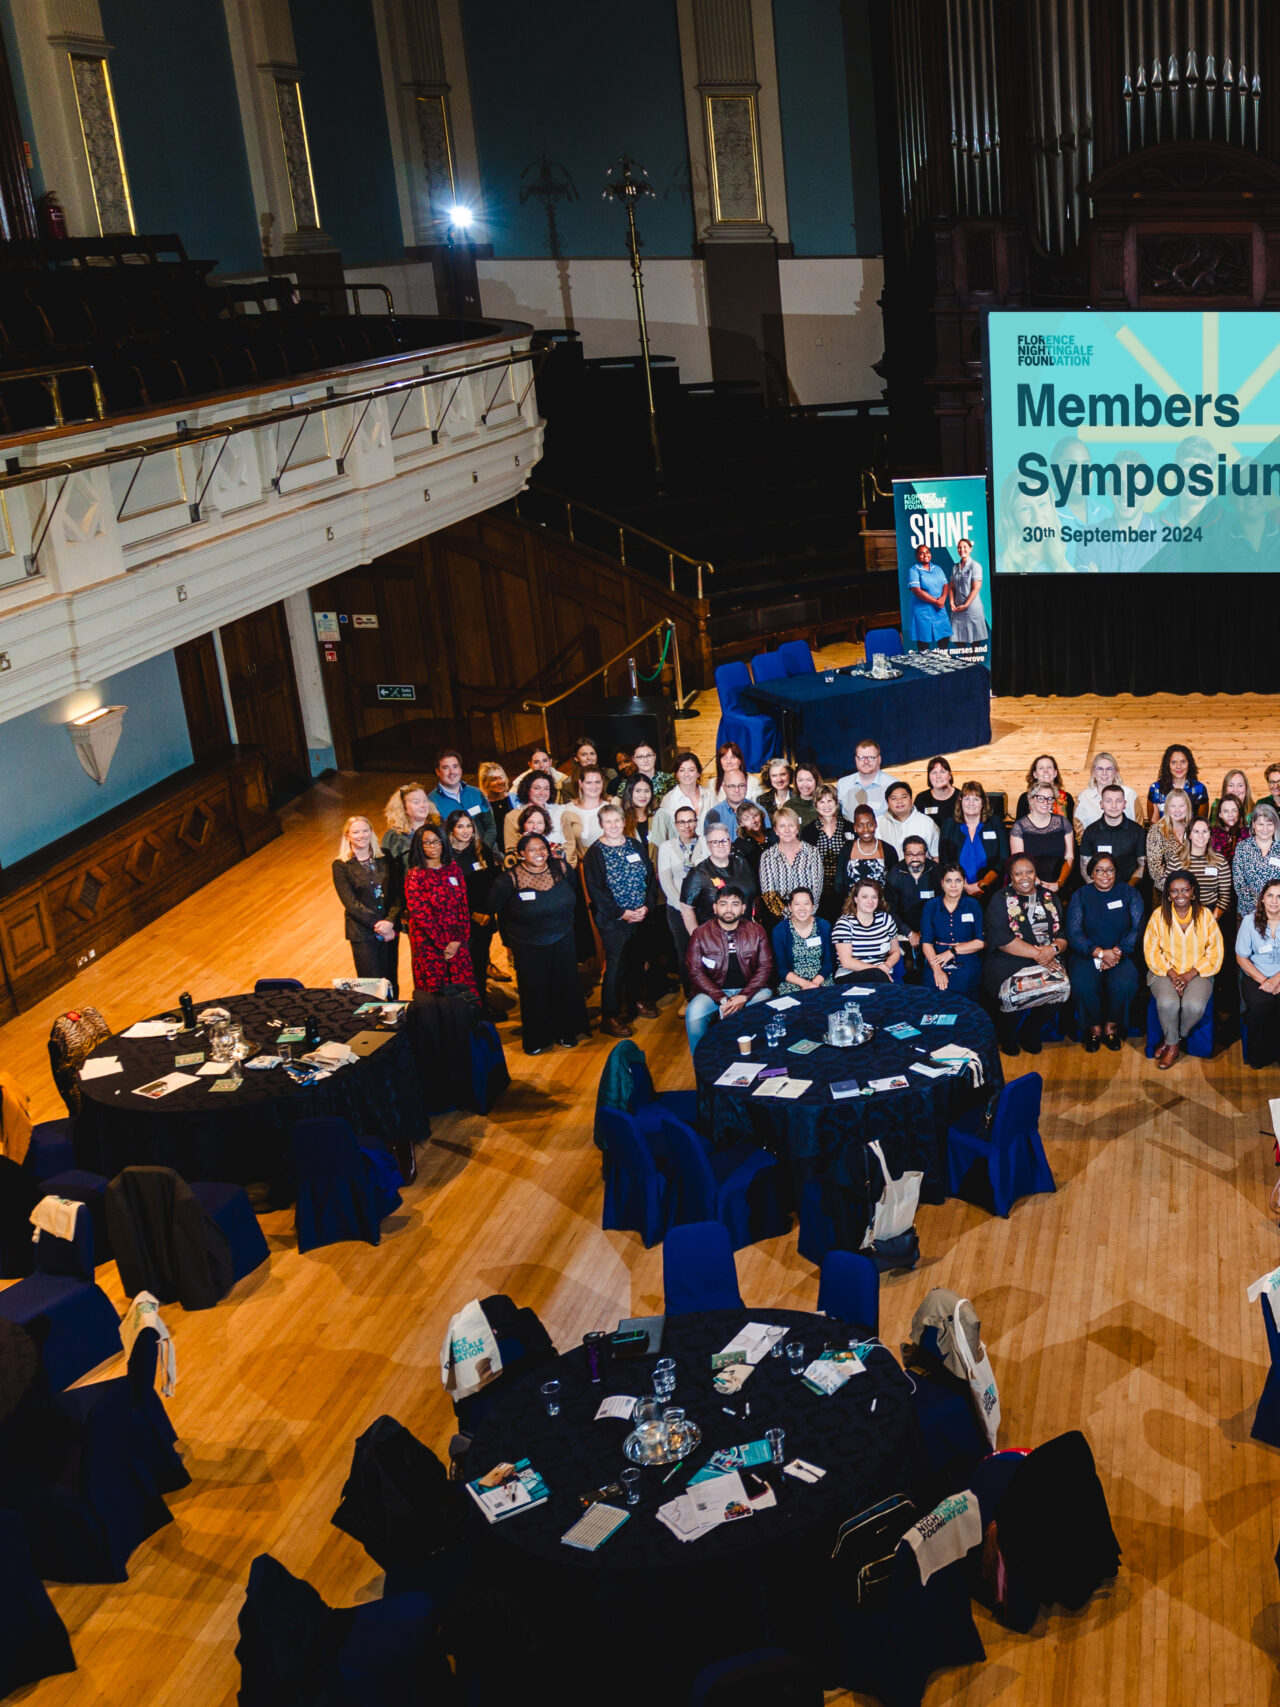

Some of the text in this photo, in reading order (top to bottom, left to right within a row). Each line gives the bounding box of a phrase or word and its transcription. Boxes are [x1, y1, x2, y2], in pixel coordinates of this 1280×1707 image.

[1017, 335, 1075, 345] FLORENCE
[1018, 345, 1094, 355] NIGHTINGALE
[1018, 356, 1090, 366] FOUNDATION
[1016, 383, 1241, 428] Members
[909, 511, 975, 549] SHINE
[1022, 526, 1204, 547] 30th September 2024
[974, 644, 988, 653] and
